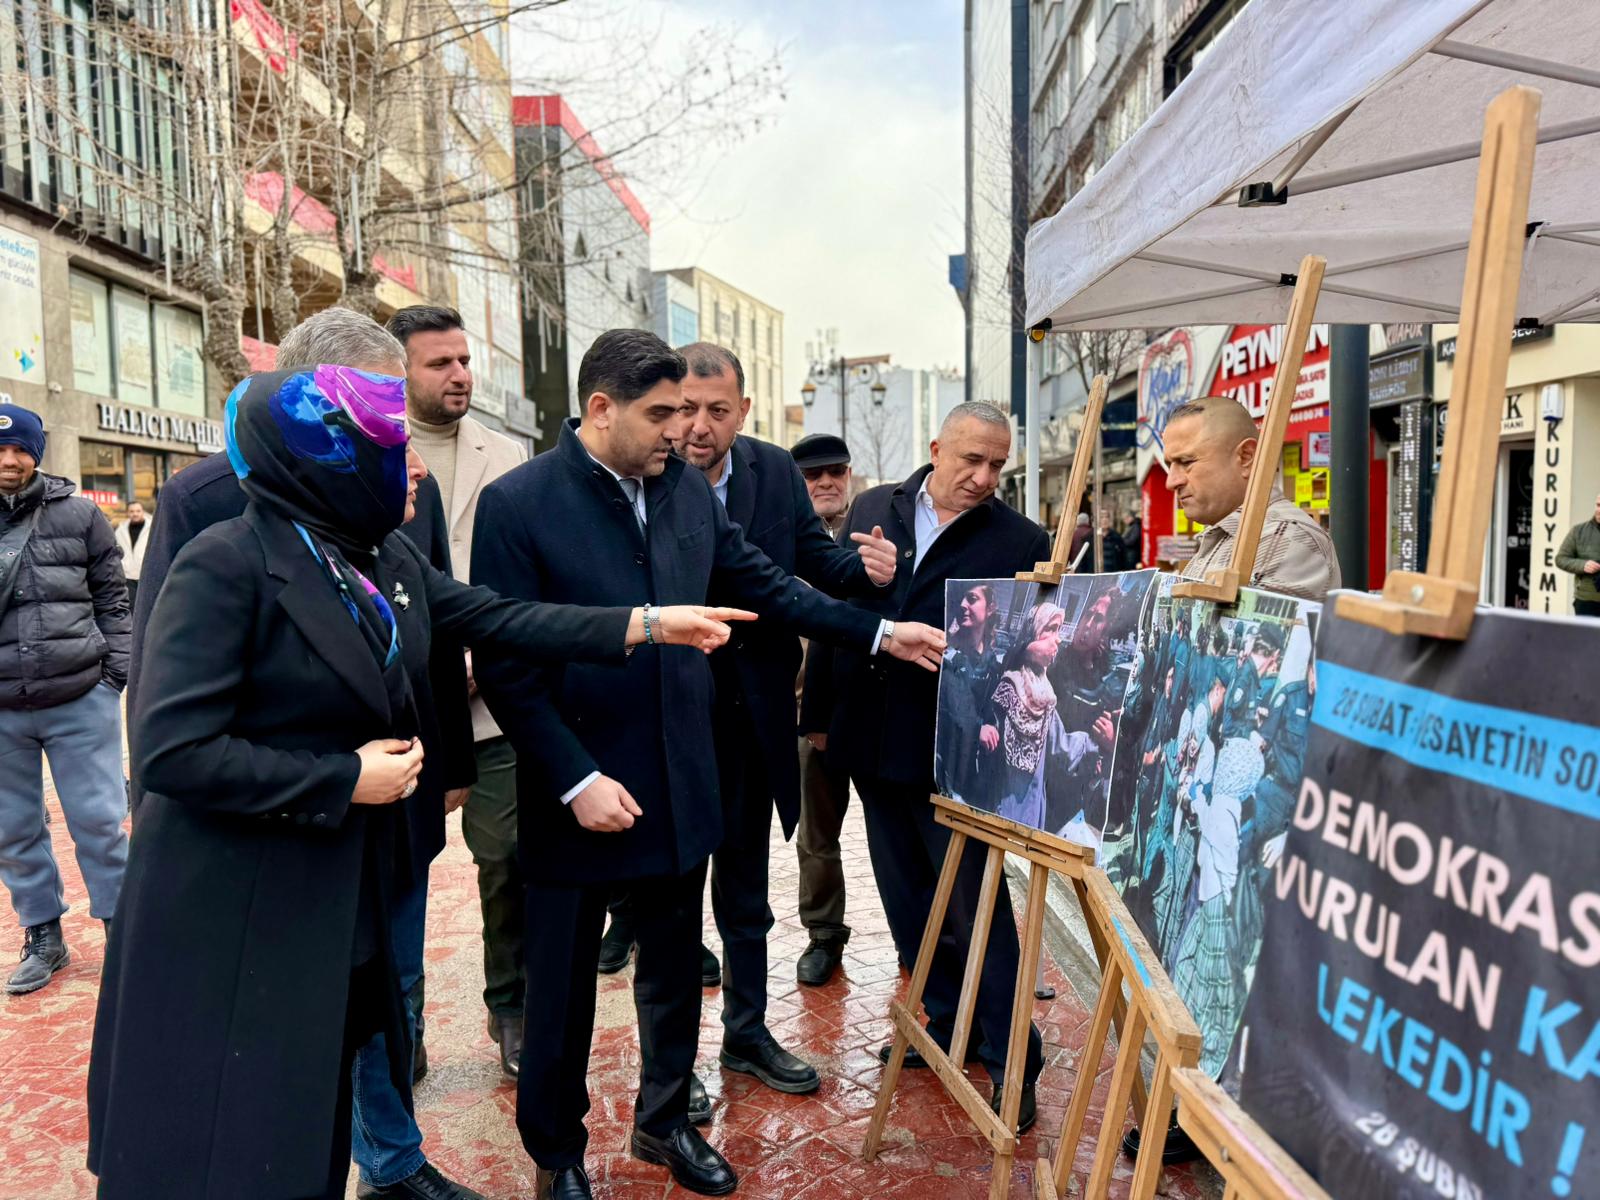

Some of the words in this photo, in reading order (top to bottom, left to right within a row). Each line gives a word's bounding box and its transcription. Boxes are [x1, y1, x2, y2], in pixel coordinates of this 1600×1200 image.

[1275, 854, 1502, 1032] VURULAN
[1317, 962, 1531, 1168] LEKEDİR
[1354, 1111, 1399, 1147] 28
